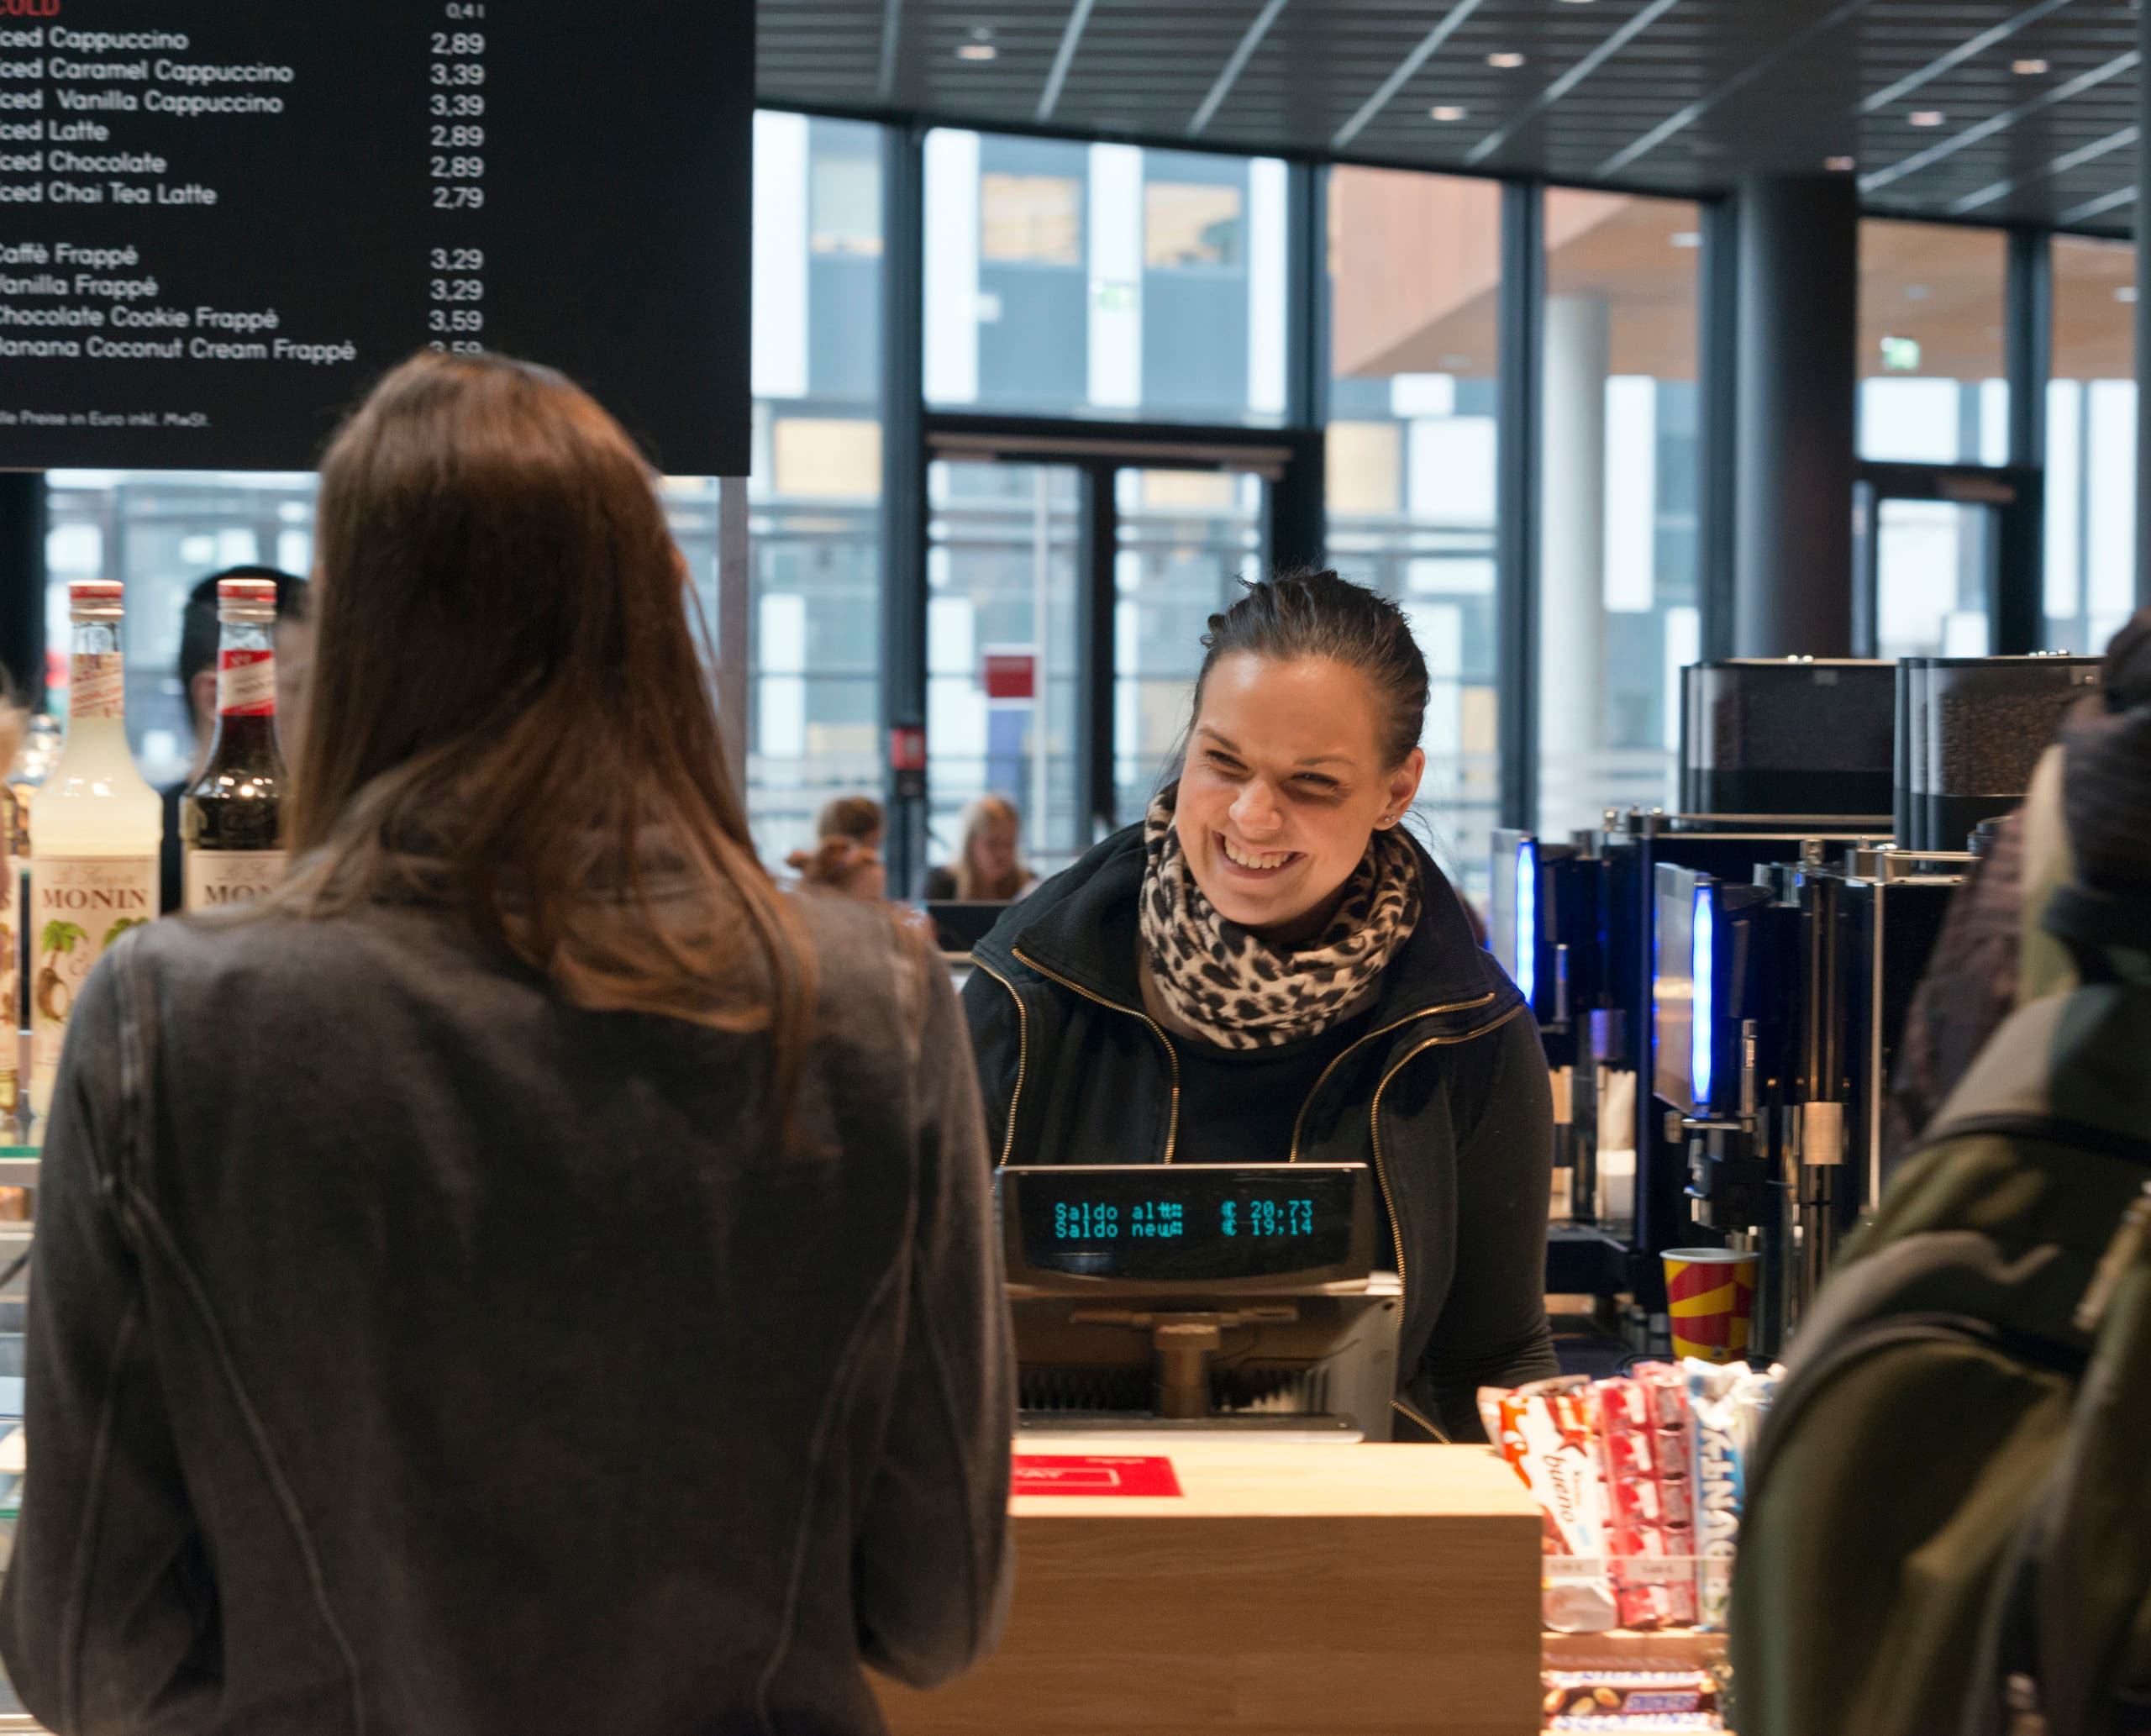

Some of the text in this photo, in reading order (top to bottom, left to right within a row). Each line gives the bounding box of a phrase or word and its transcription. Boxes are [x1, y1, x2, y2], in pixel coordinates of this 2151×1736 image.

[0, 26, 189, 53] ced Cappuccino
[431, 33, 486, 55] 2,89
[0, 57, 294, 86] ced Caramel Cappuccino
[430, 63, 486, 87] 3,39
[0, 88, 284, 117] ced Vanilla Cappuccino
[430, 94, 485, 117] 3,39
[0, 119, 110, 142] ced Latte
[430, 125, 485, 148] 2,89
[0, 150, 168, 173] ced Chocolate
[430, 156, 485, 179] 2,89
[0, 181, 218, 206] ced Chai Tea Latte
[433, 187, 485, 209] 2,79
[55, 243, 139, 271] Frappé
[430, 248, 484, 271] 3,29
[75, 274, 160, 301] Frappé
[430, 279, 484, 302] 3,29
[110, 305, 190, 329] Cookie
[196, 307, 280, 334] Frappé
[429, 309, 484, 333] 3,59
[86, 336, 184, 359] Coconut
[190, 337, 268, 360] Cream
[274, 339, 357, 365] Frappé
[88, 410, 125, 427] Euro
[42, 886, 147, 910] MONIN
[1055, 1202, 1118, 1220] Saldo
[1222, 1200, 1237, 1218] €
[1250, 1200, 1312, 1218] 20,73
[1055, 1219, 1118, 1239] Saldo
[1222, 1218, 1237, 1236] €
[1252, 1218, 1312, 1236] 19,14
[1542, 1455, 1575, 1523] bueno
